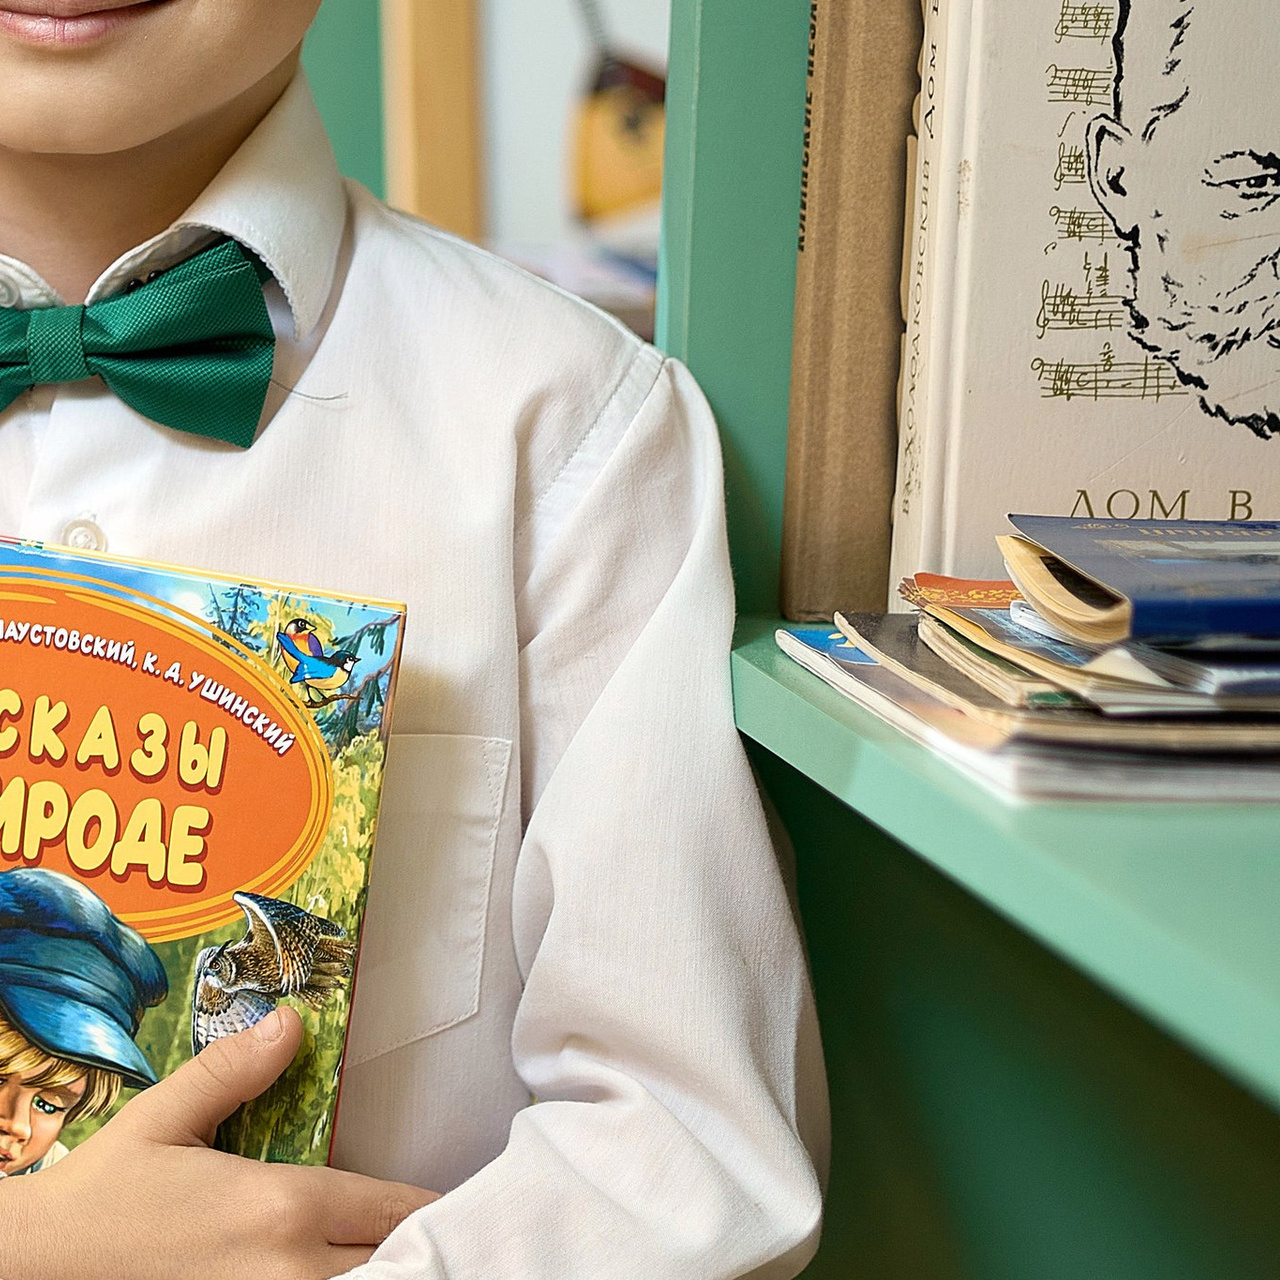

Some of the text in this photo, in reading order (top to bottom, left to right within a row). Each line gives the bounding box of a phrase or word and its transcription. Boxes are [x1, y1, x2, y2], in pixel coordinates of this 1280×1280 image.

[1227, 489, 1254, 521] В
[142, 651, 162, 676] К.
[164, 661, 186, 686] Д.
[188, 670, 298, 757] УШИНСКИЙ
